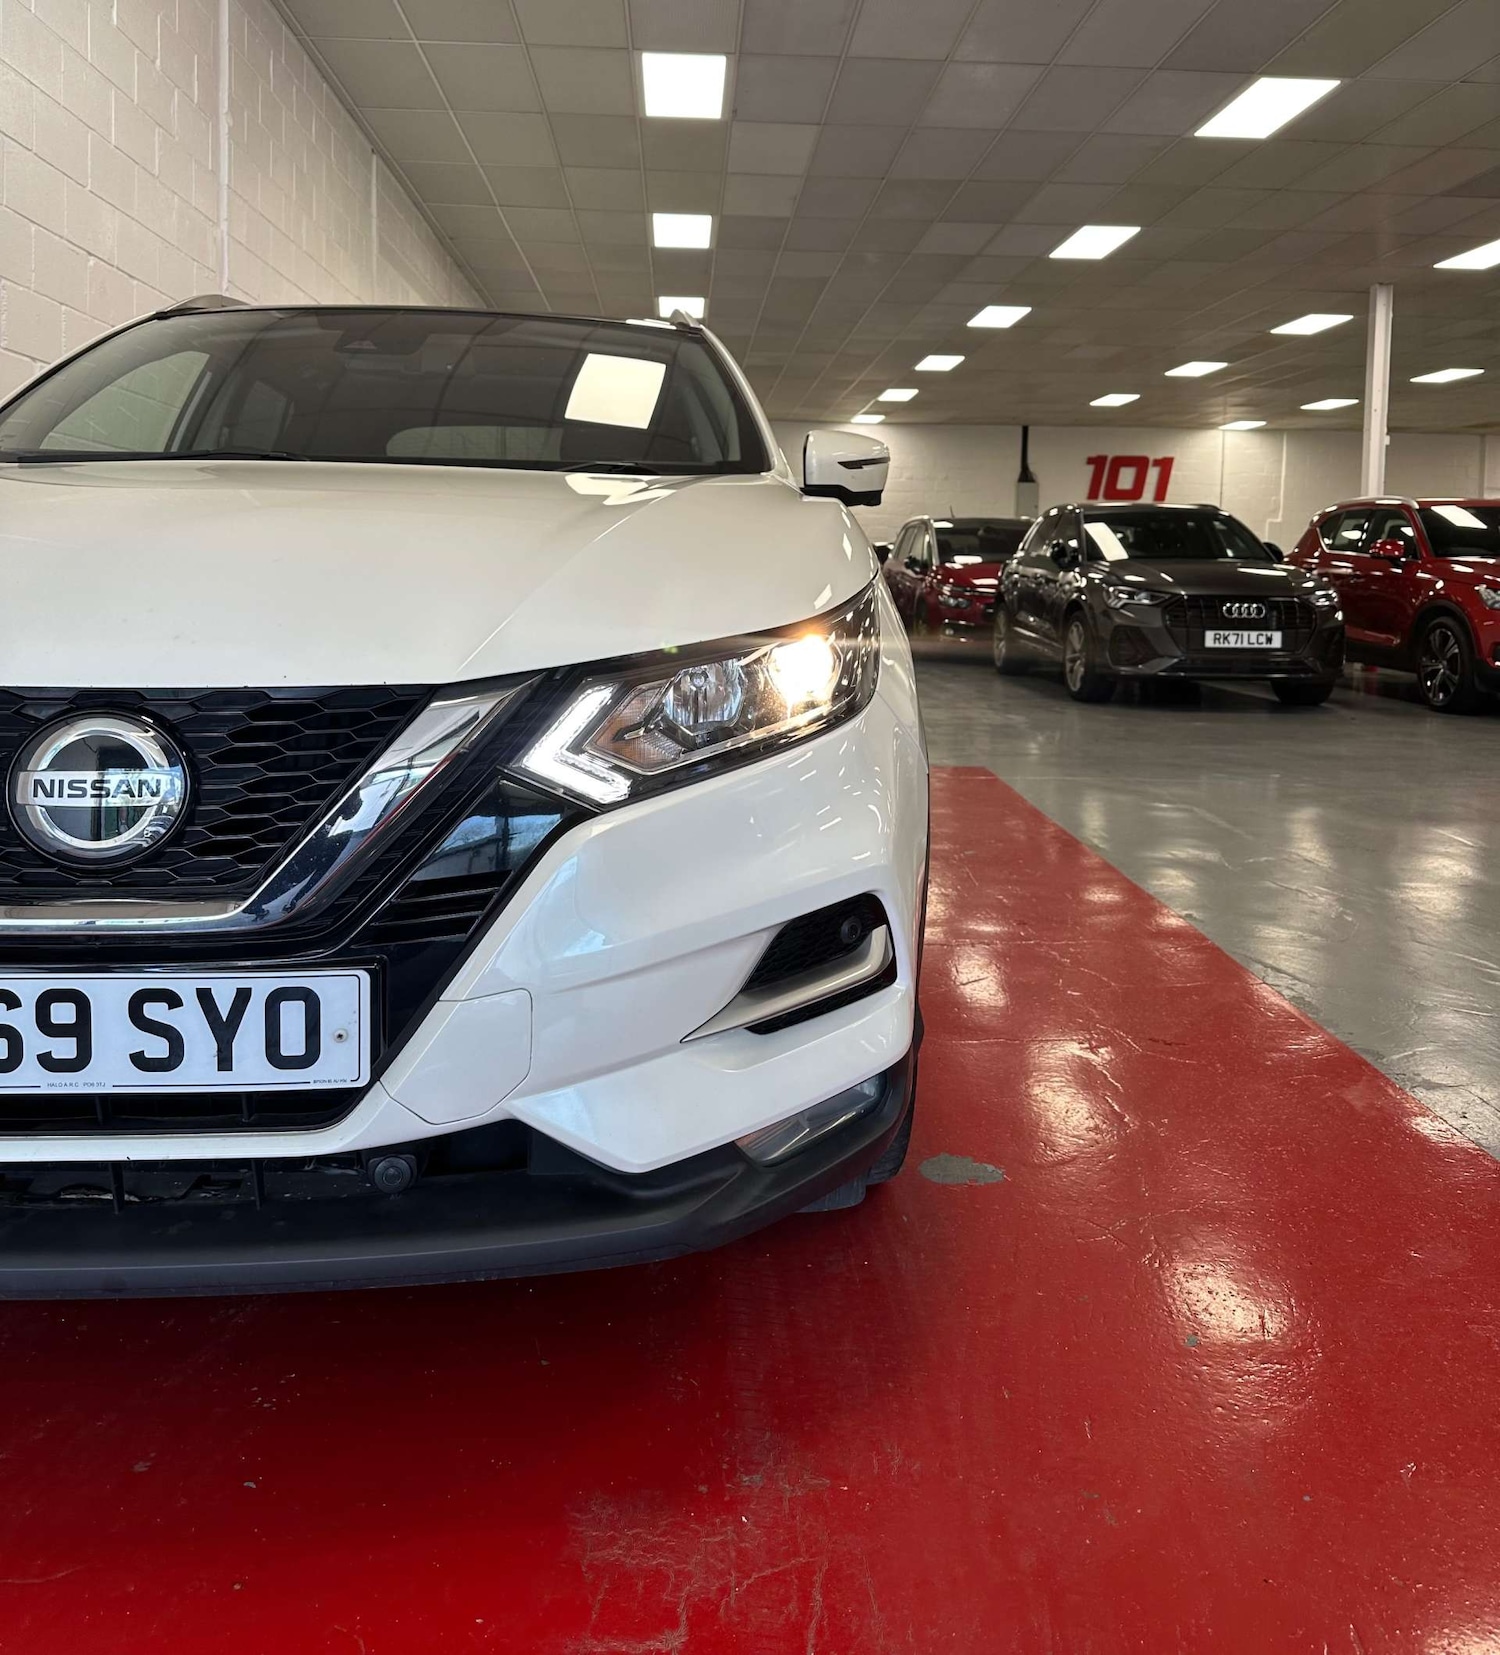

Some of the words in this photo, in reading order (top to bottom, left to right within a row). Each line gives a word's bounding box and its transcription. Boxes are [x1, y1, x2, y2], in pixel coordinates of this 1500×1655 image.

[1086, 455, 1175, 502] 101
[1213, 633, 1244, 645] RK71
[1247, 633, 1273, 645] LCW
[33, 779, 161, 798] NISSAN
[128, 986, 321, 1073] SYO
